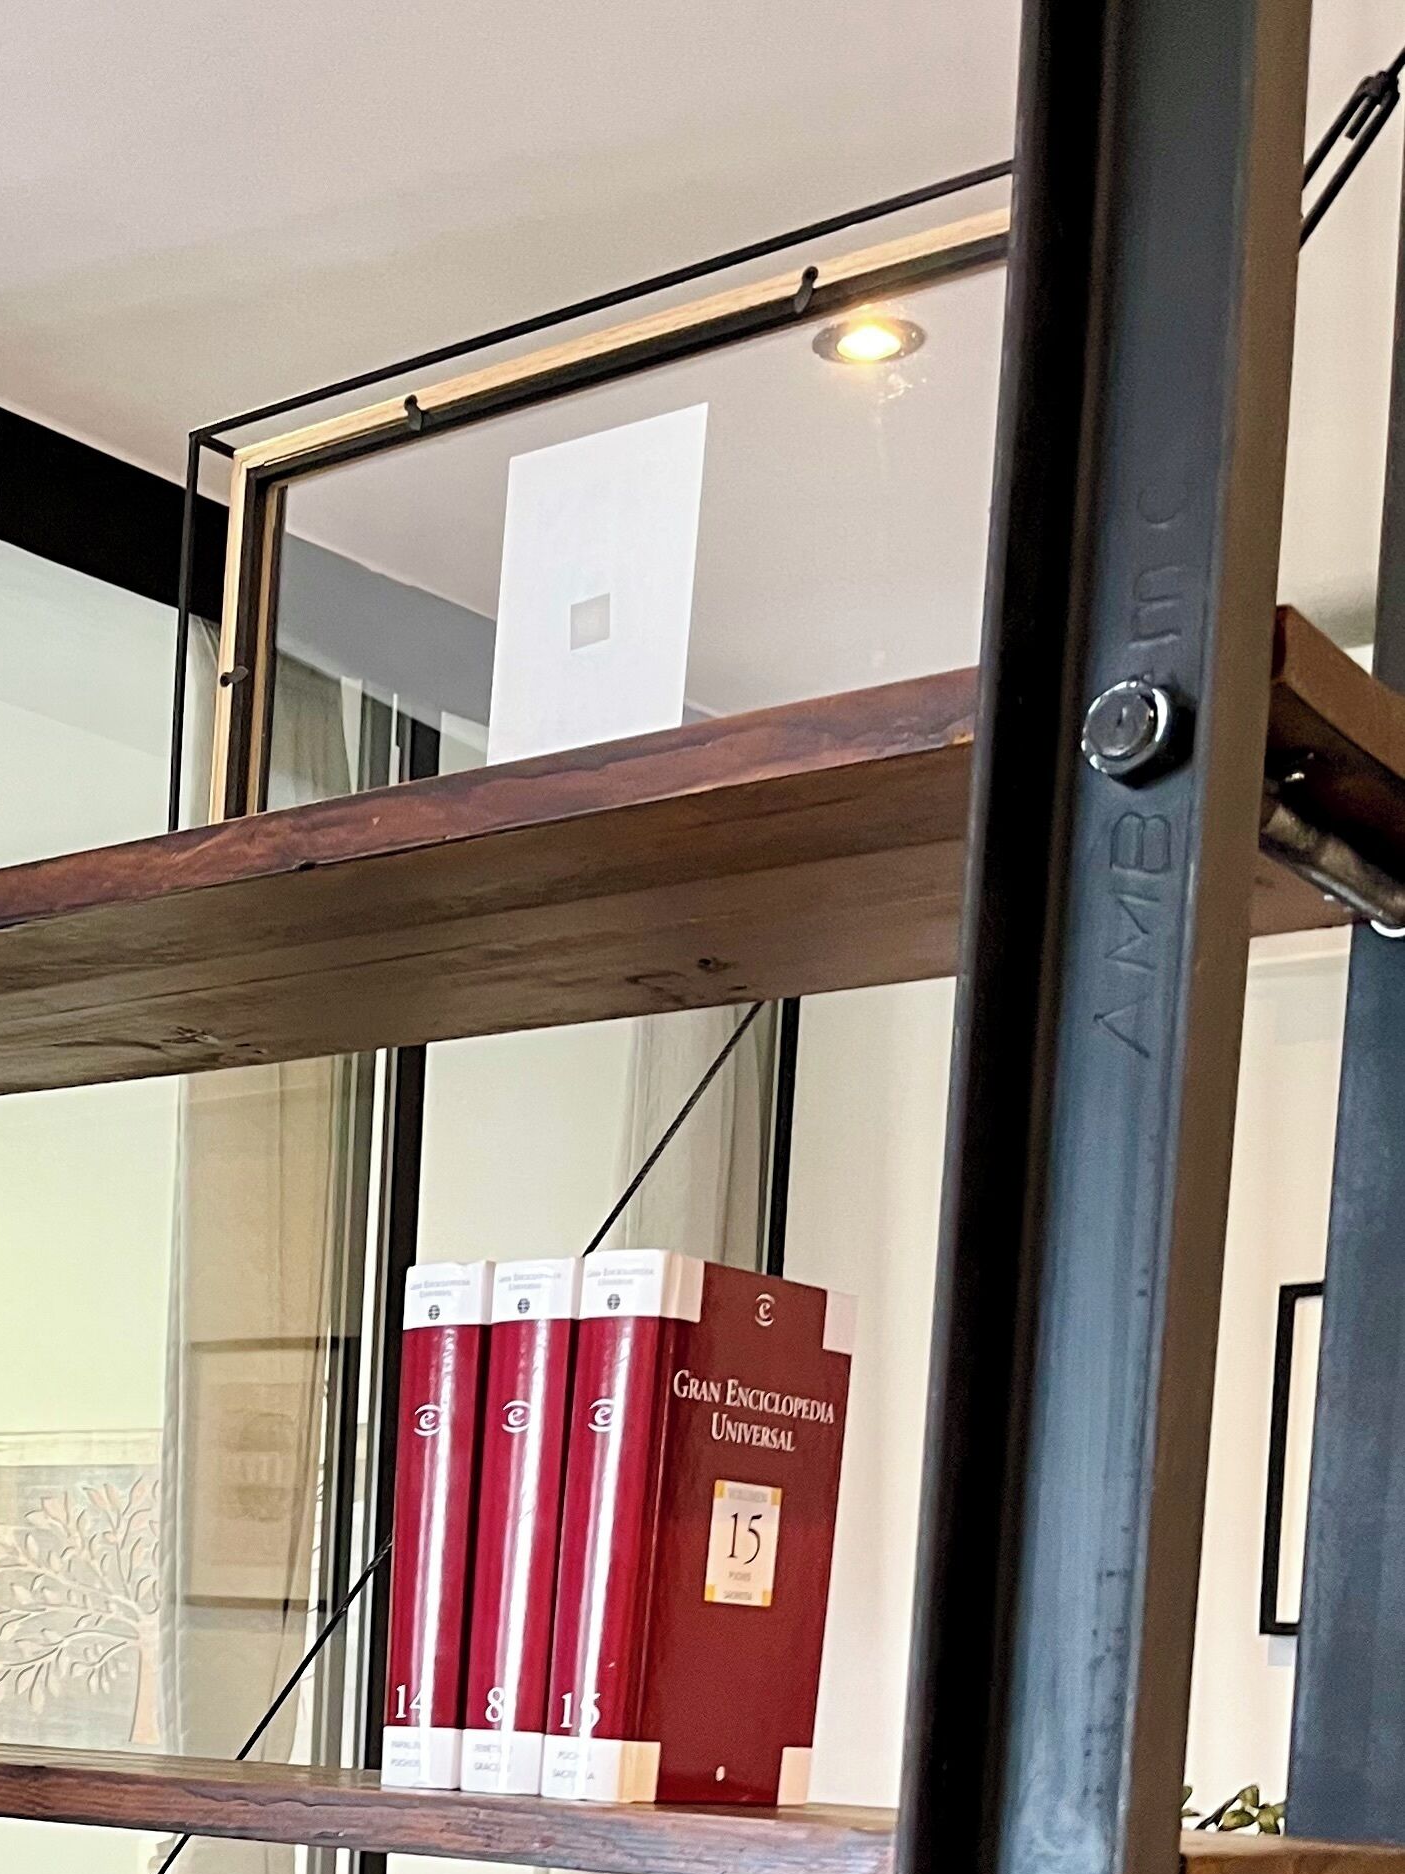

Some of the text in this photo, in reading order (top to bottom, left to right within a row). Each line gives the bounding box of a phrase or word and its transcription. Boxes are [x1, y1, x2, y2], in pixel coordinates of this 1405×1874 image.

[673, 1369, 835, 1424] GRAN ENCICLOPEDIA
[711, 1411, 795, 1452] UNIVERSAL
[727, 1512, 763, 1565] 15
[485, 1686, 506, 1723] 8
